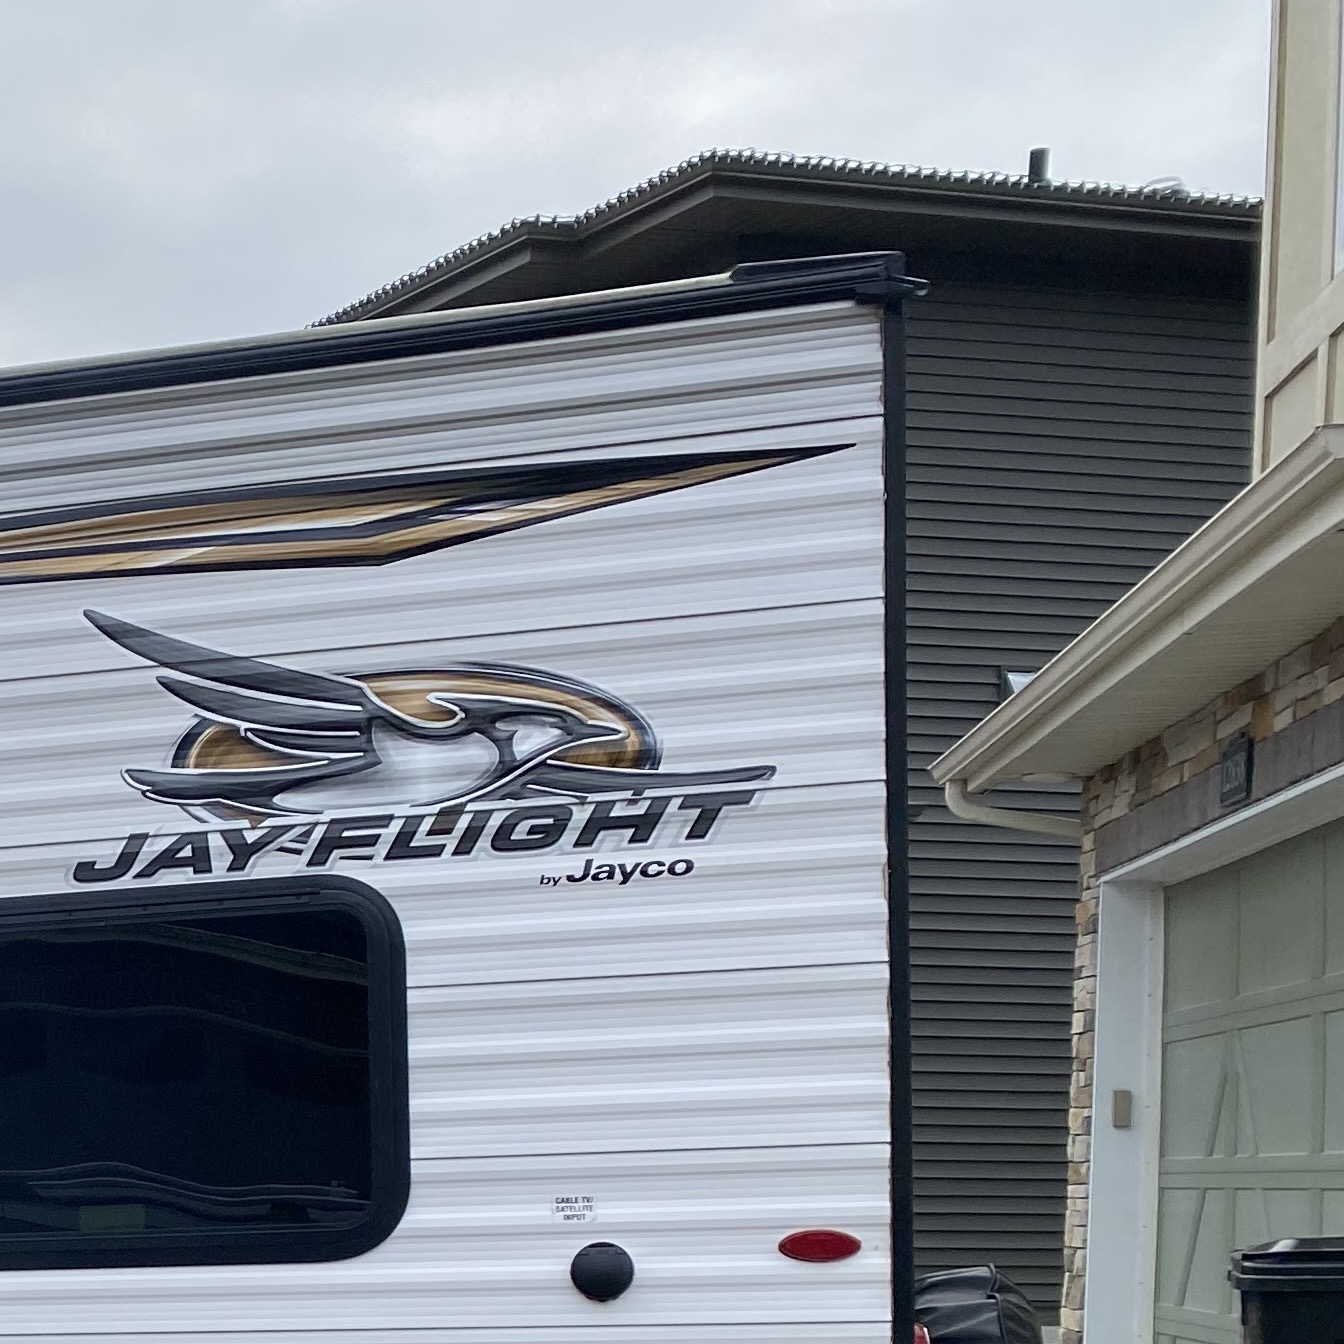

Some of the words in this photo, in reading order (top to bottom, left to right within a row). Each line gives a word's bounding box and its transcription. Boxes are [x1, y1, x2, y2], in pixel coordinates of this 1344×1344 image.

[71, 822, 300, 884] JAY
[305, 788, 759, 868] FLIGHT
[539, 873, 562, 888] by
[565, 857, 696, 886] Jayco
